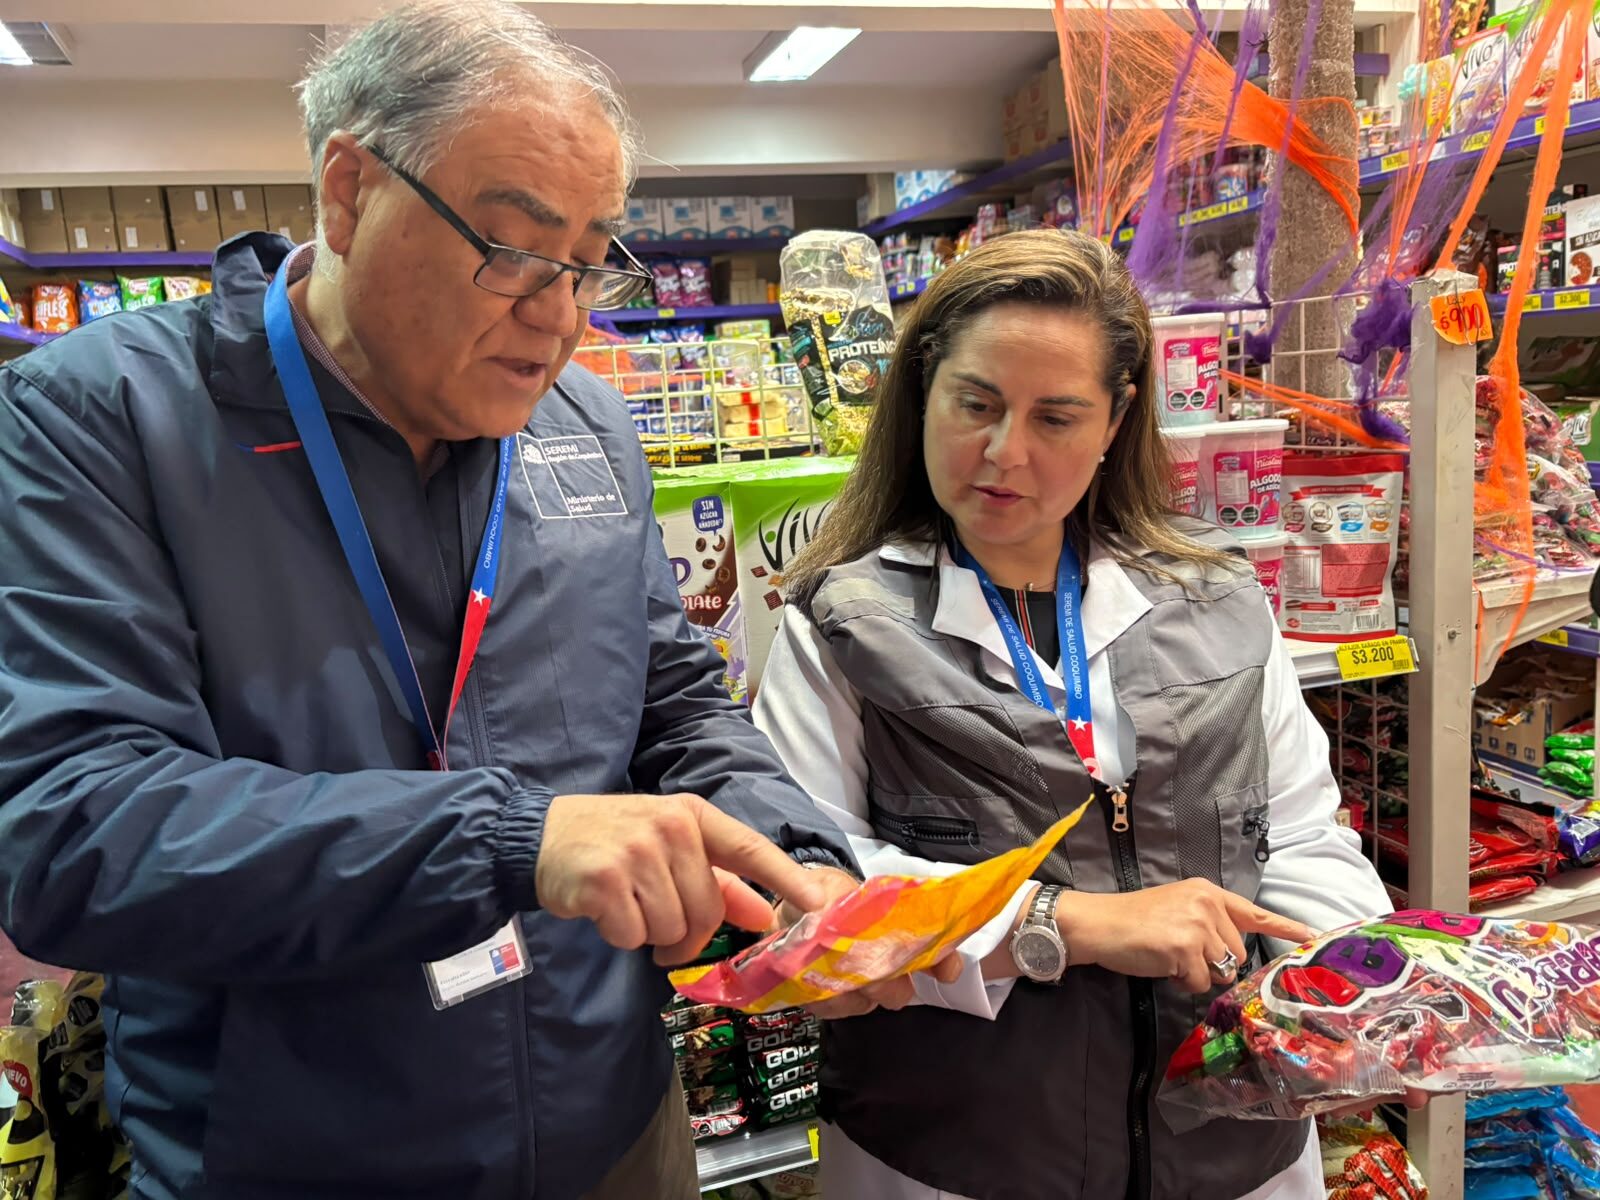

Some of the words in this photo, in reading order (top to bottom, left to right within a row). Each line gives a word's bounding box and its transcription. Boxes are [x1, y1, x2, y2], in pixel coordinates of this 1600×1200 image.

[544, 444, 579, 456] SEREMI
[566, 494, 606, 505] Ministerio
[606, 492, 617, 502] de
[569, 503, 593, 513] Salud
[701, 500, 714, 511] SIN
[483, 514, 499, 569] COQUIMBO
[1064, 591, 1073, 616] SEREMI
[1065, 617, 1074, 627] DE
[1066, 628, 1077, 655] SALUD
[991, 597, 1010, 624] SEREMI
[1006, 623, 1016, 639] DE
[1012, 636, 1027, 662] SALUD
[1022, 662, 1044, 707] COQUIMBO
[1351, 646, 1395, 665] $3.200
[1069, 656, 1082, 699] COQUIMBO
